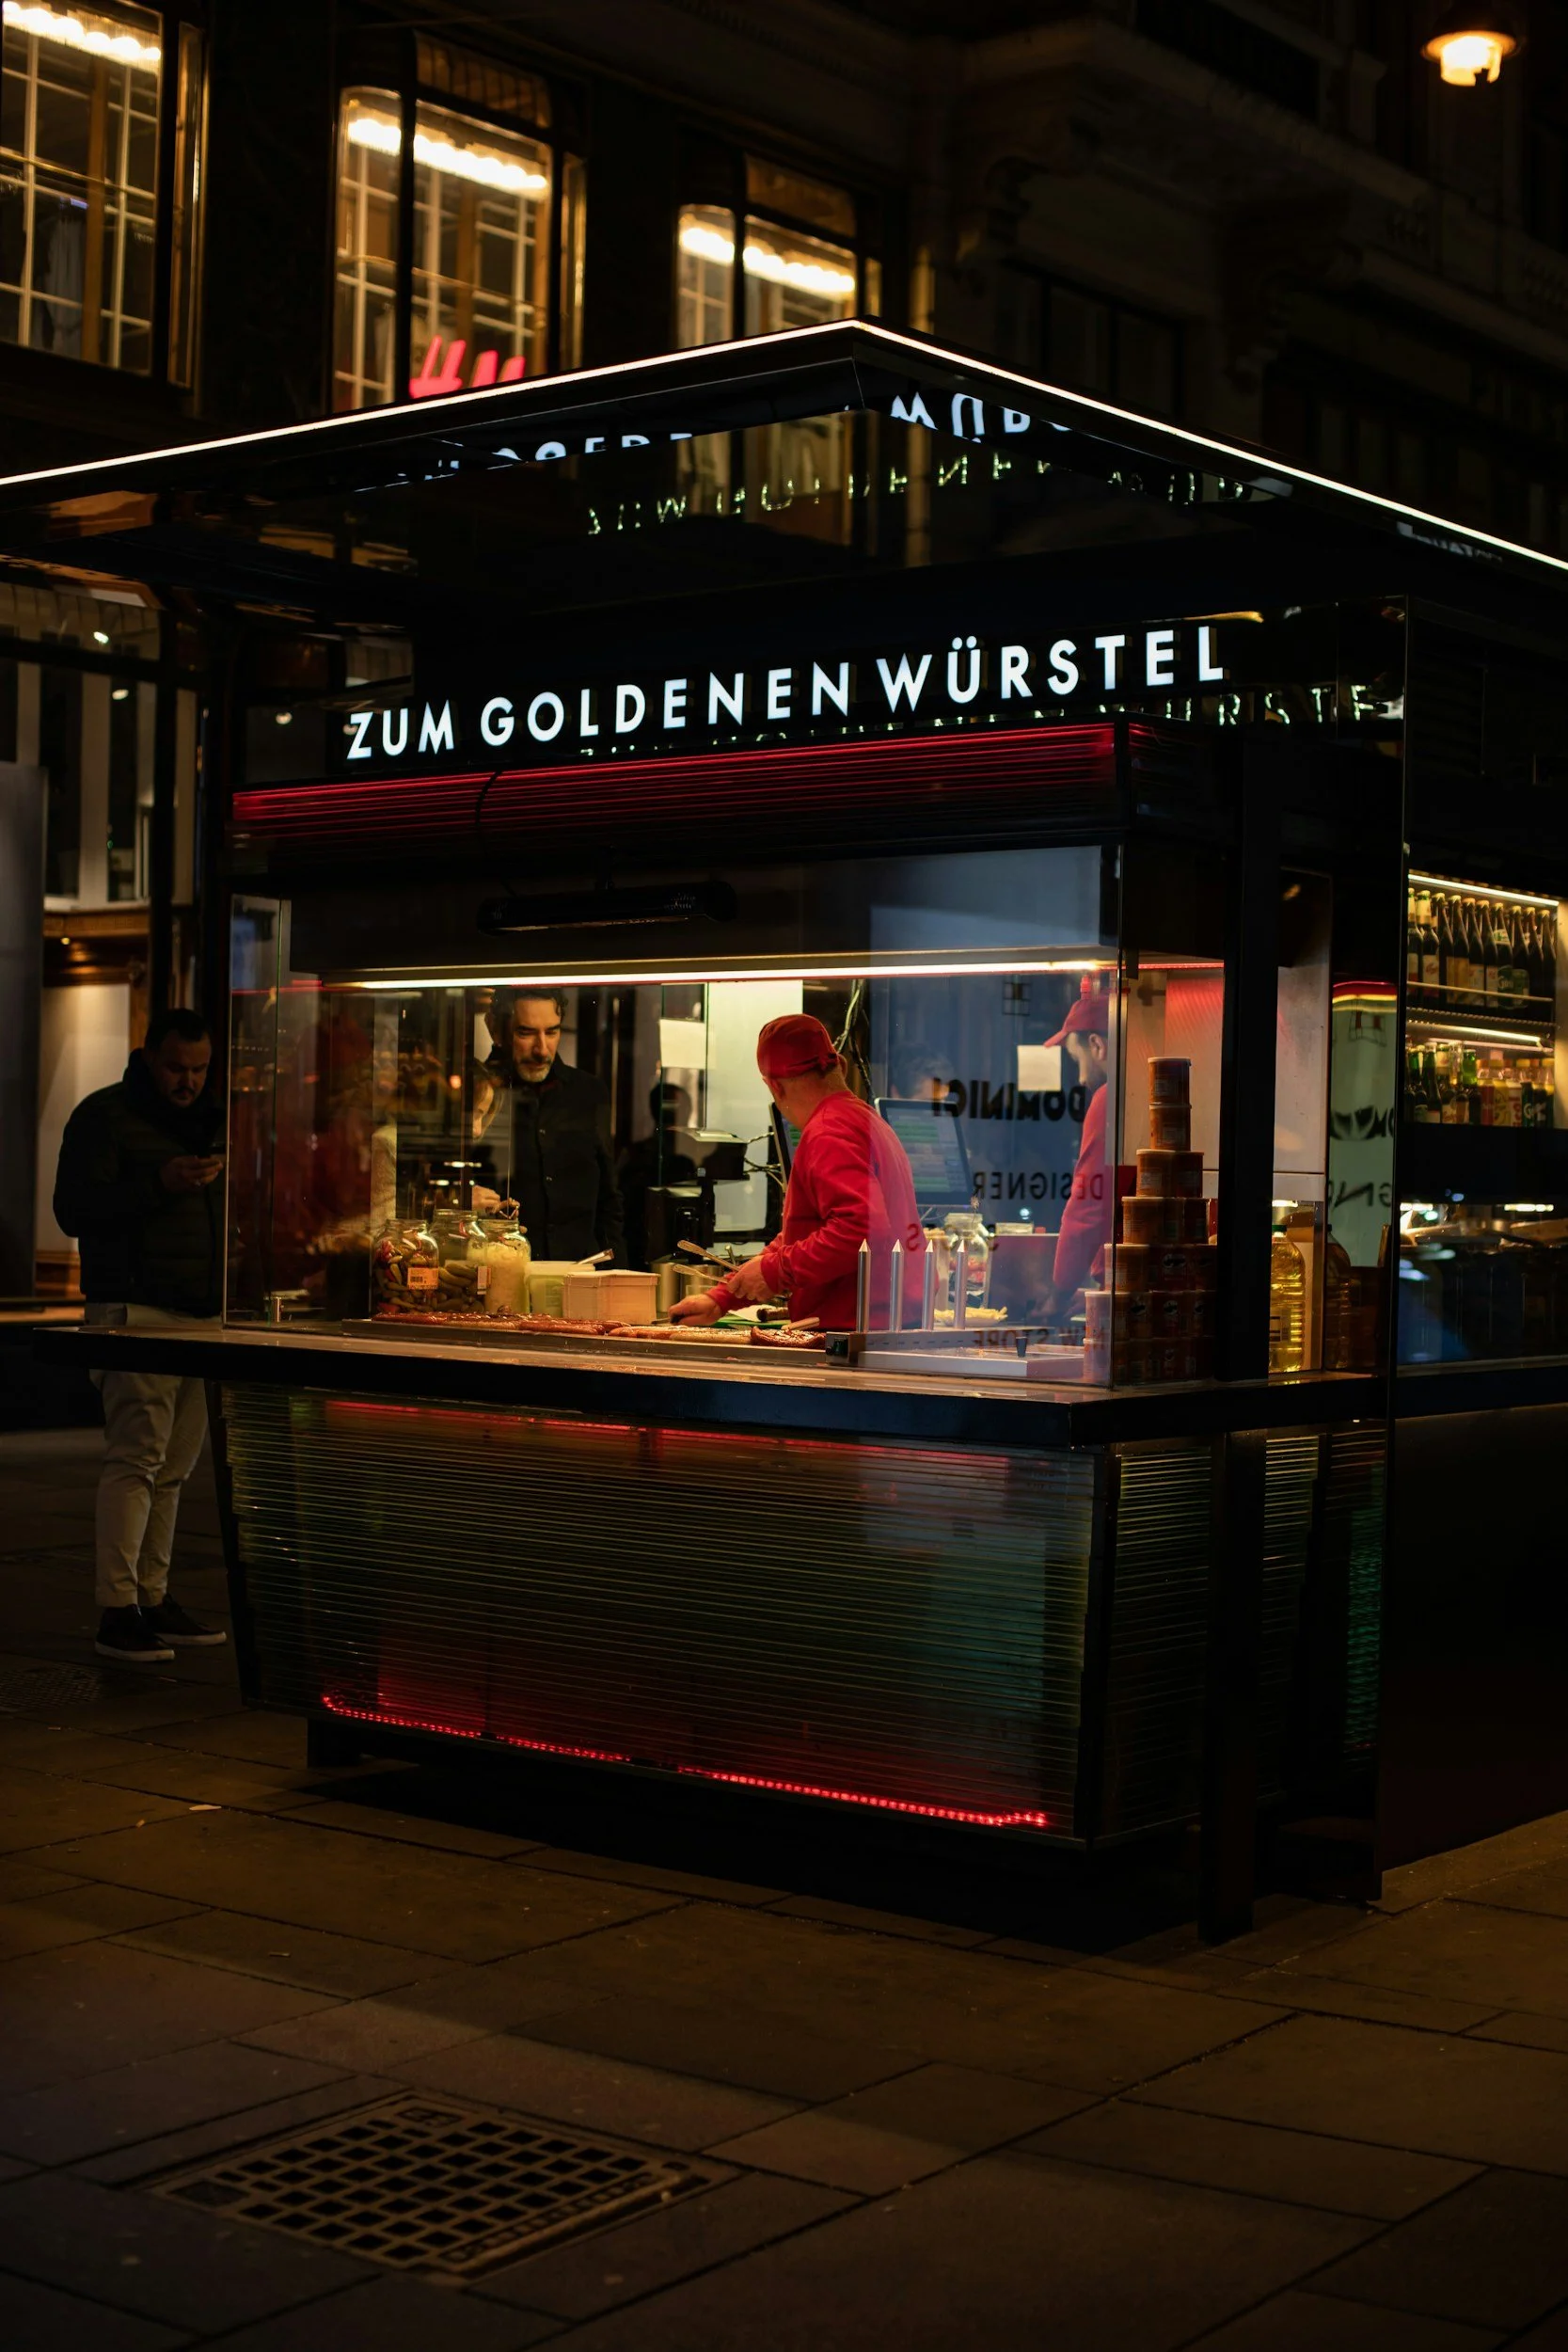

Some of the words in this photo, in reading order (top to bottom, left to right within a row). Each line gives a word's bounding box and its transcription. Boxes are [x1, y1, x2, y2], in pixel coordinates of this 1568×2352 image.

[346, 700, 455, 760] ZUM
[480, 660, 850, 747] GOLDENEN
[875, 625, 1225, 713] WÜRSTEL
